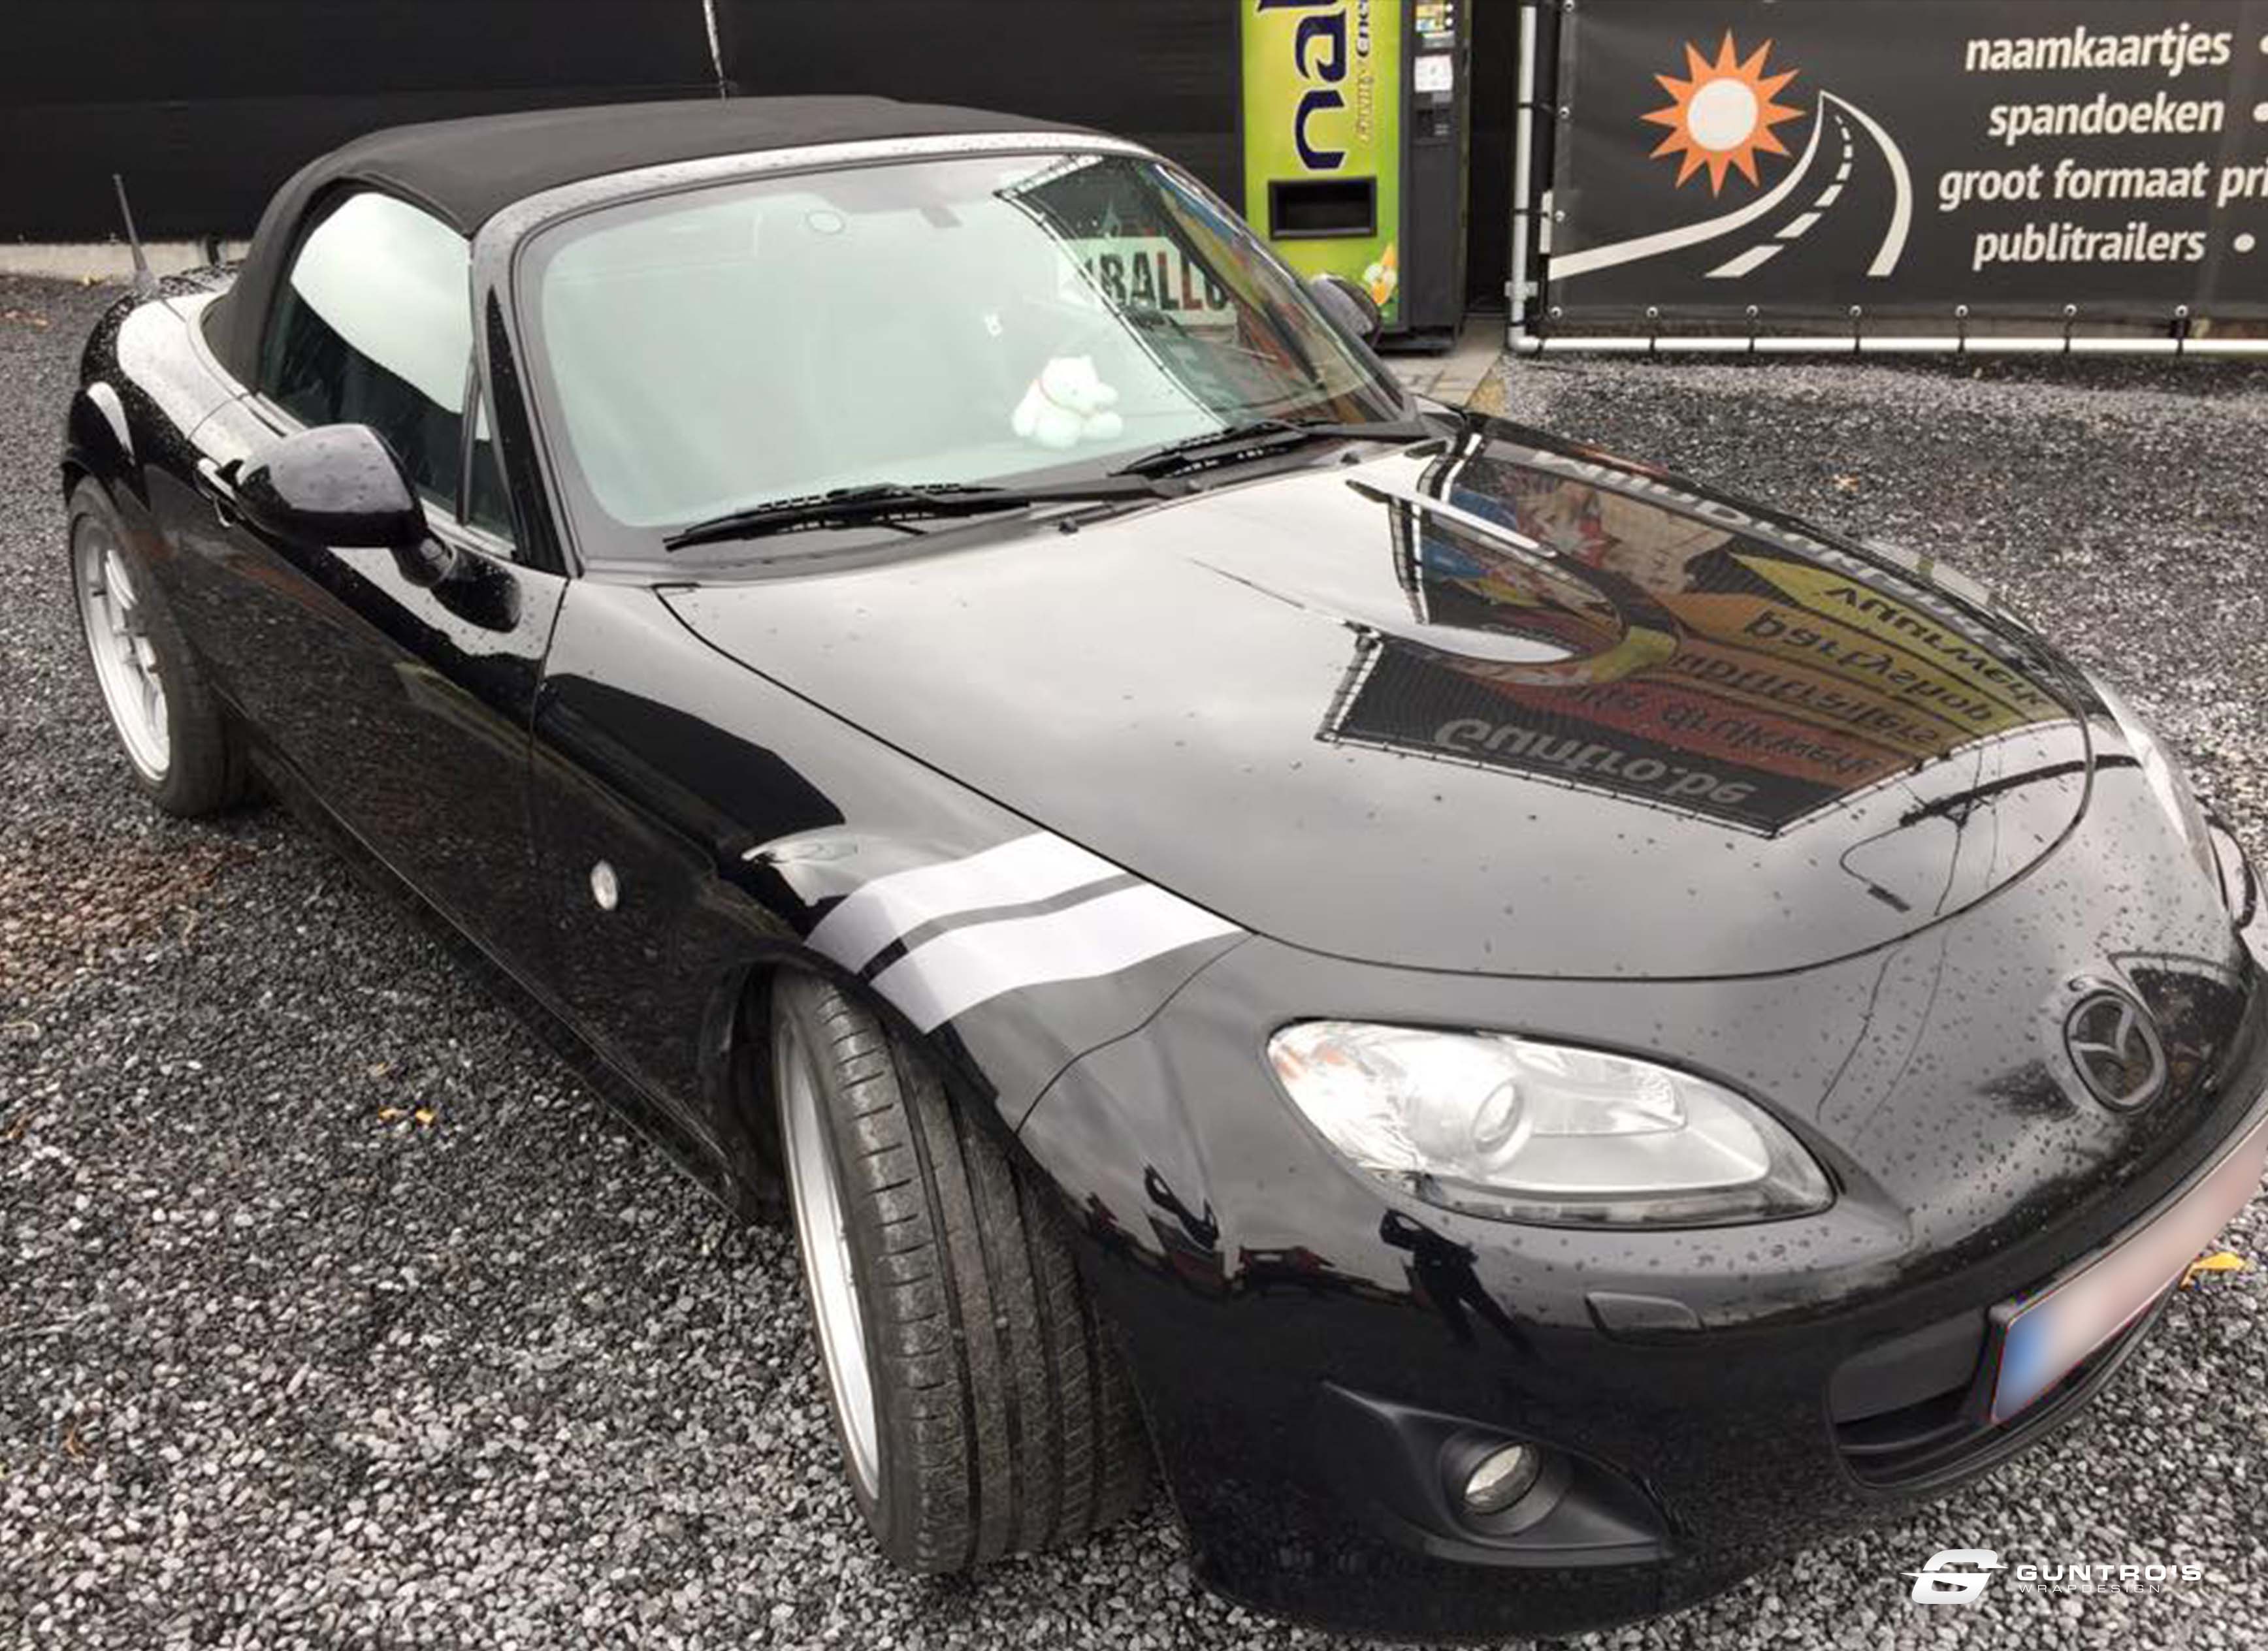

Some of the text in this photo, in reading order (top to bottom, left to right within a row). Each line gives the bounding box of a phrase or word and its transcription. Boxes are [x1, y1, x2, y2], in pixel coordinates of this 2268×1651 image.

[1965, 22, 2233, 77] naamkaartjes
[1988, 91, 2225, 146] spandoeken
[1938, 164, 2044, 212] groot
[2053, 159, 2210, 200] formaat
[1973, 221, 2207, 271] publitrailers
